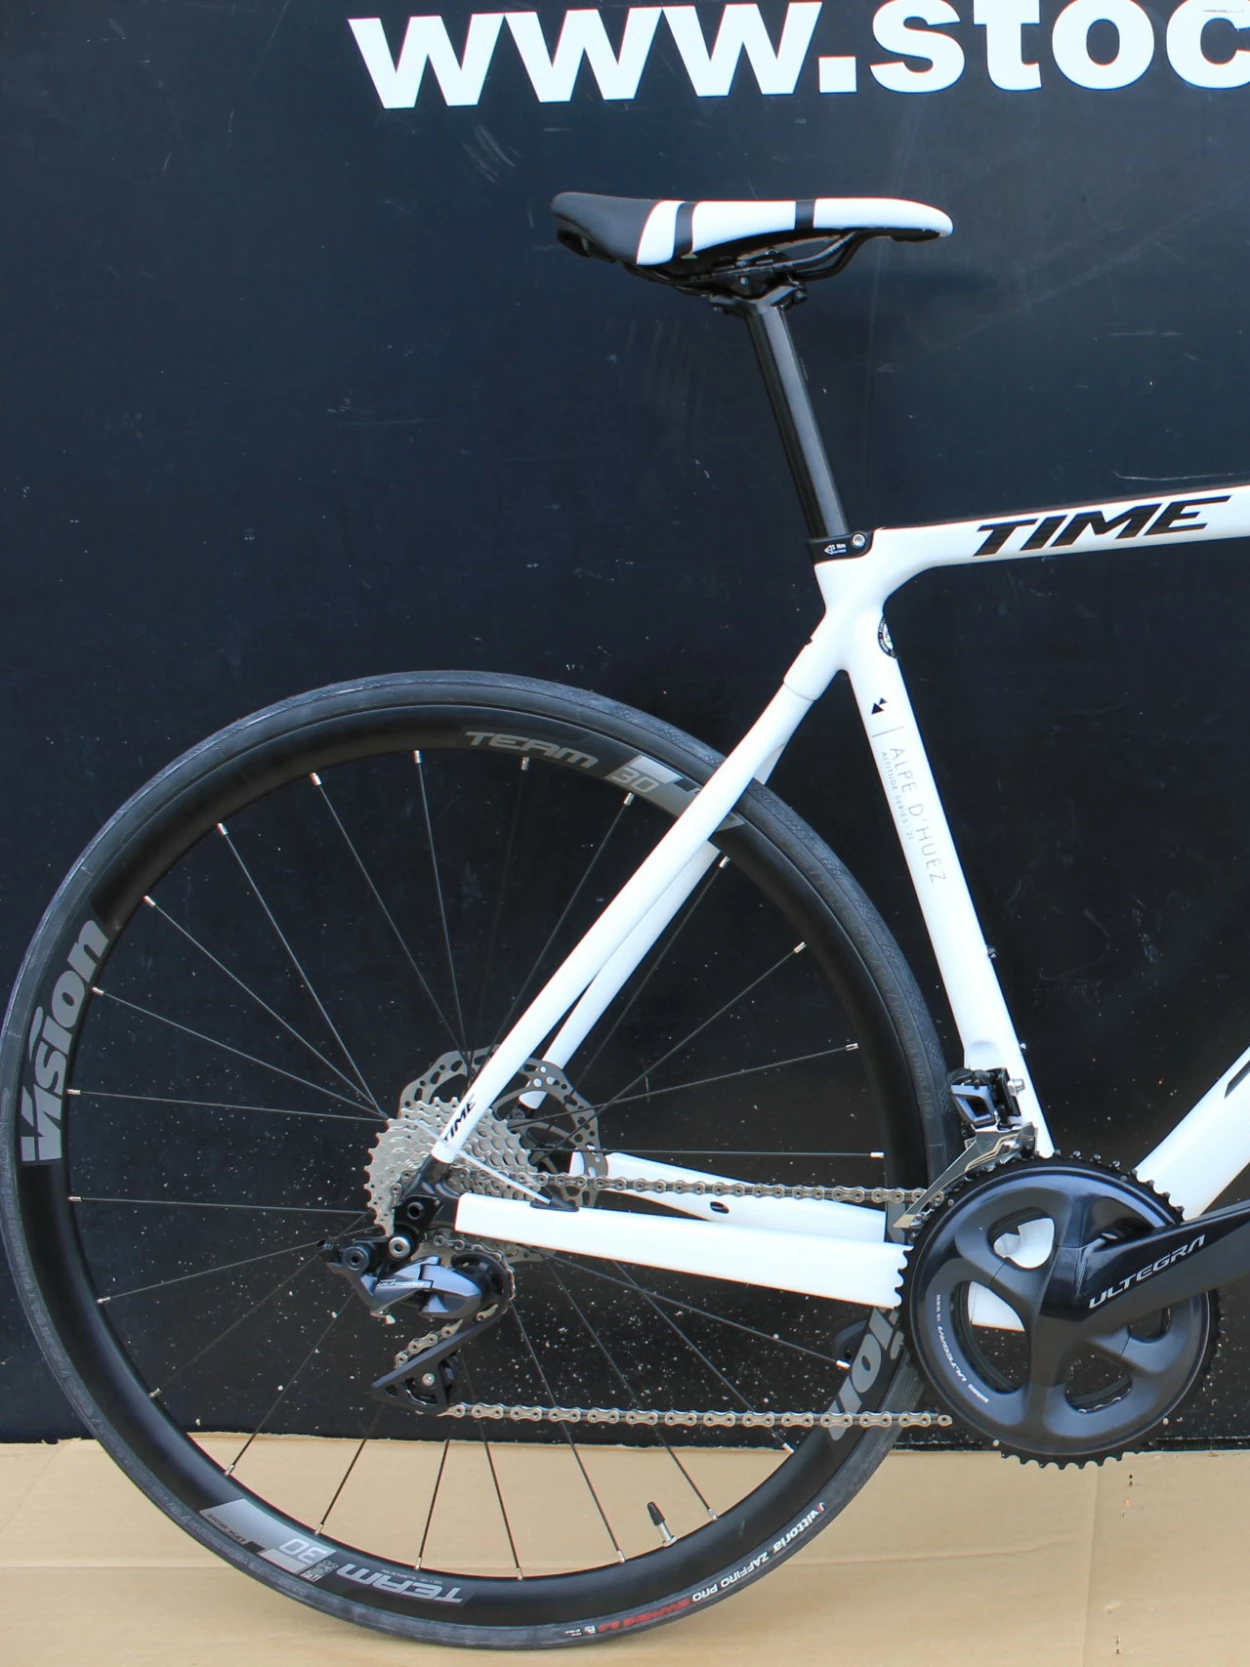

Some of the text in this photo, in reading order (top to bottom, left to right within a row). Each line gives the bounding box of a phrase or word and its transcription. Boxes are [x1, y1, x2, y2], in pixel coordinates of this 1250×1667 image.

[973, 495, 1232, 557] TIME
[465, 731, 660, 793] TEAM 30
[881, 751, 898, 791] ALTITUDE
[890, 748, 946, 883] ALPE D'HUEZ
[20, 919, 110, 1162] Vision
[1089, 1234, 1205, 1309] ULTEGRA
[279, 1538, 330, 1565] 30
[774, 1510, 819, 1552] vittoria
[336, 1563, 463, 1604] TEAM
[692, 1583, 719, 1603] PRO
